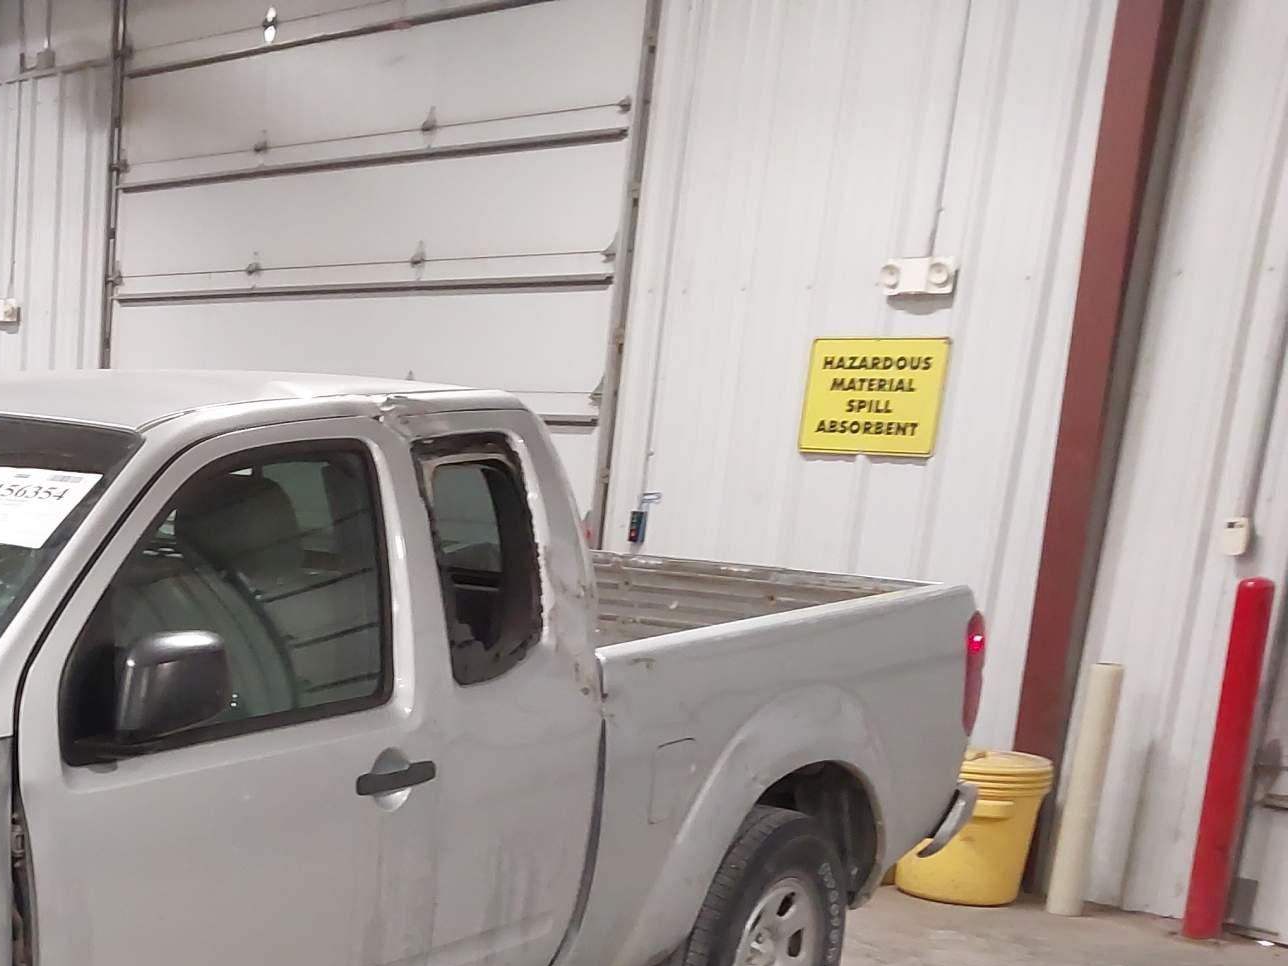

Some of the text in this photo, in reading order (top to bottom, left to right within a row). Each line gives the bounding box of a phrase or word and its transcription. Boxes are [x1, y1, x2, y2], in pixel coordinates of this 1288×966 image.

[822, 356, 933, 371] HAZARDOUS
[830, 377, 916, 392] MATERIAL
[845, 399, 893, 414] SPILL
[815, 420, 918, 436] ABSORBENT
